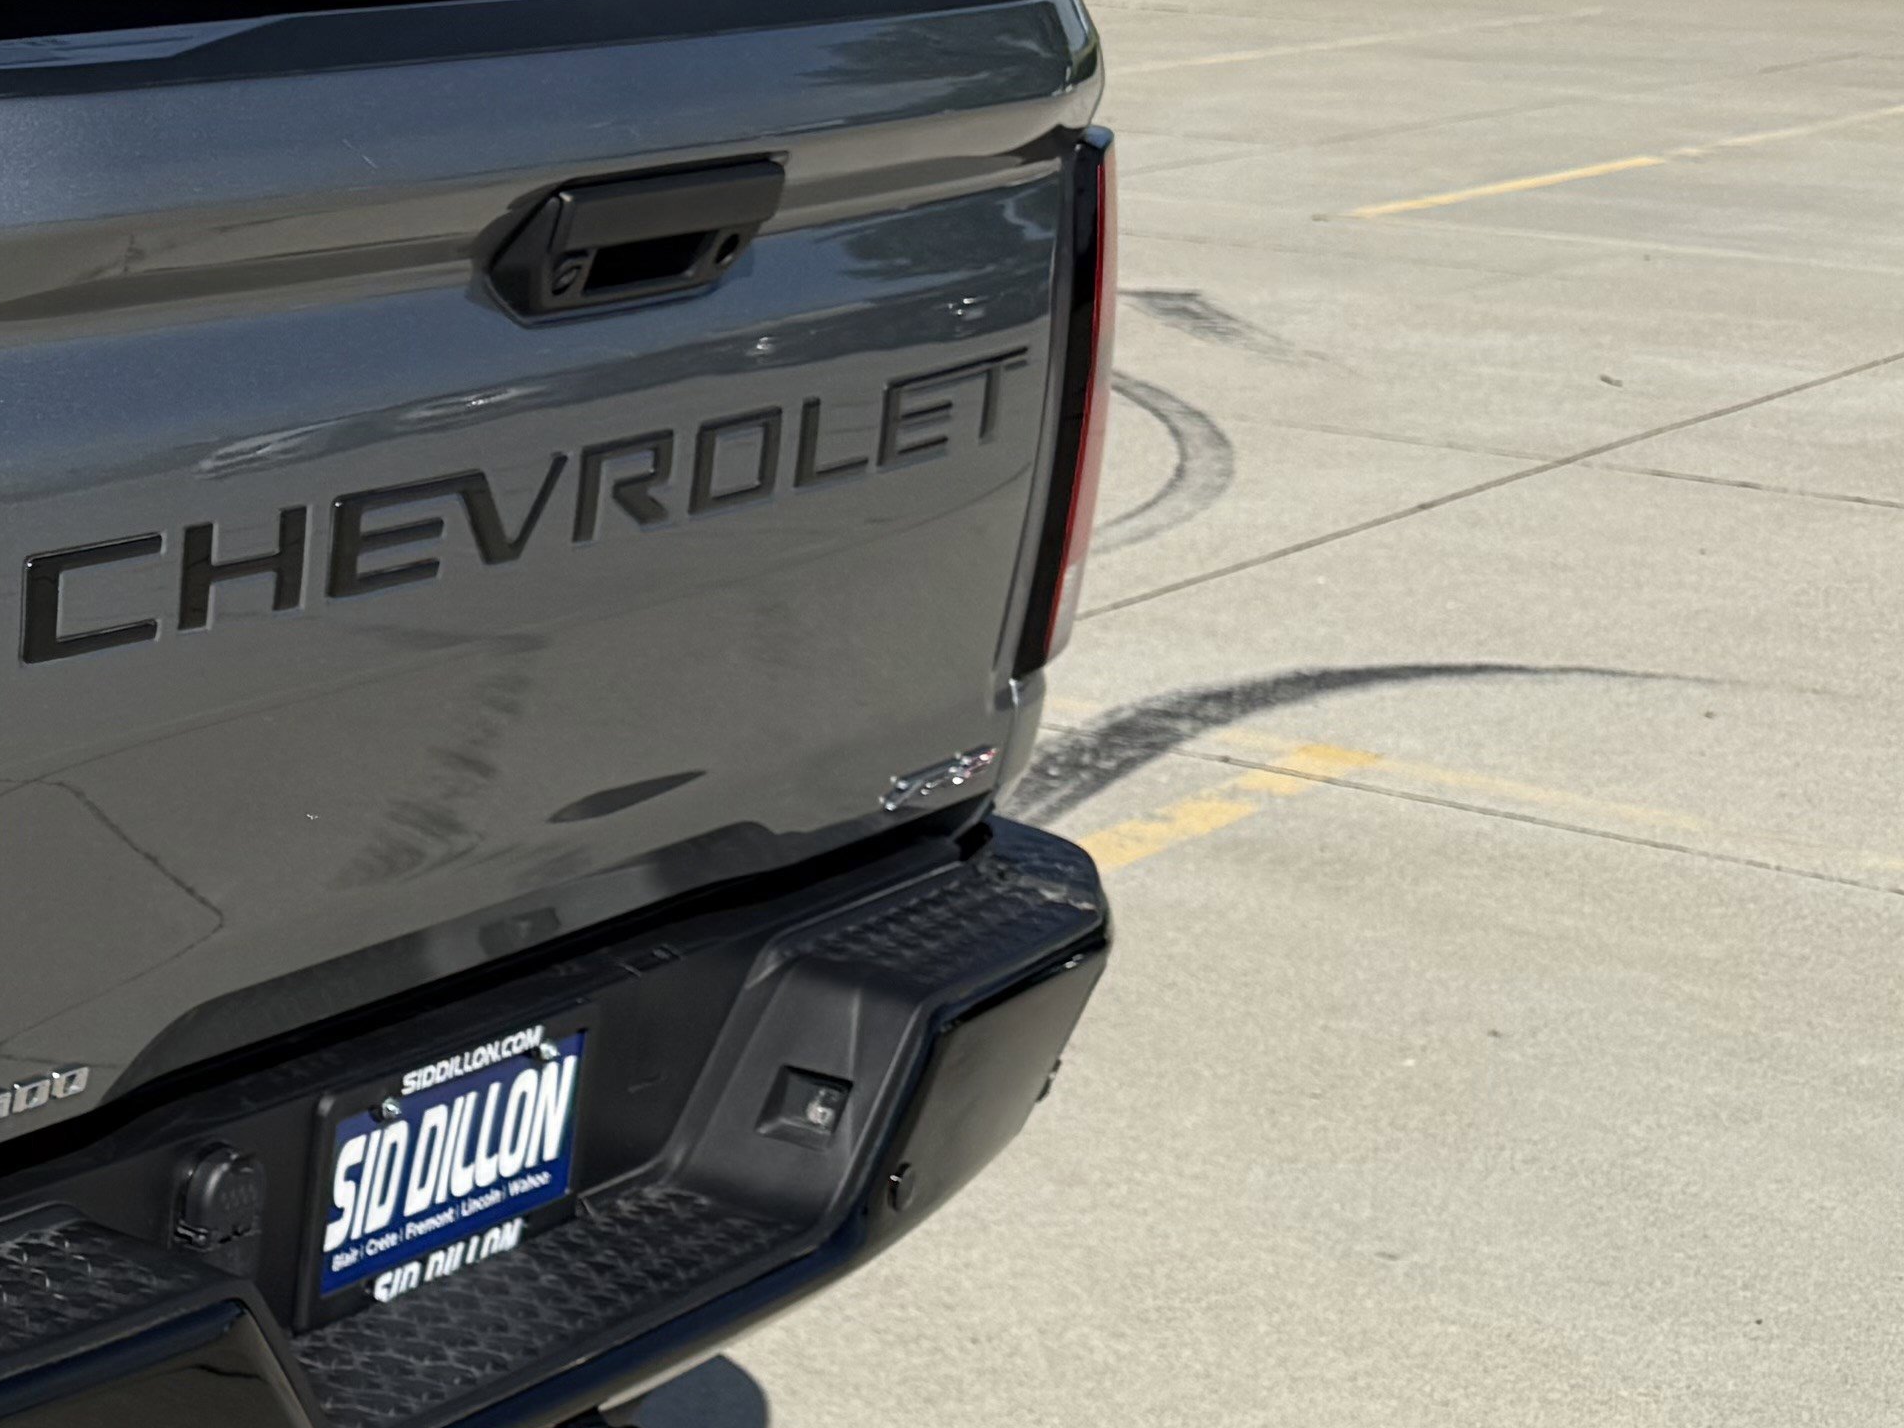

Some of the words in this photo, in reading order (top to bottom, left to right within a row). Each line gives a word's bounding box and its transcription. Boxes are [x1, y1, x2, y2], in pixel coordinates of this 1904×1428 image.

[21, 346, 1029, 665] CHEVROLET
[401, 1025, 544, 1095] SIDDILLON.COM
[323, 1119, 409, 1252] SID
[404, 1055, 578, 1217] DILLON
[331, 1250, 361, 1272] Blair
[365, 1230, 399, 1256] Crete
[405, 1207, 456, 1240] Fremont
[461, 1188, 503, 1217] Lincoln
[509, 1171, 552, 1197] Wahoo
